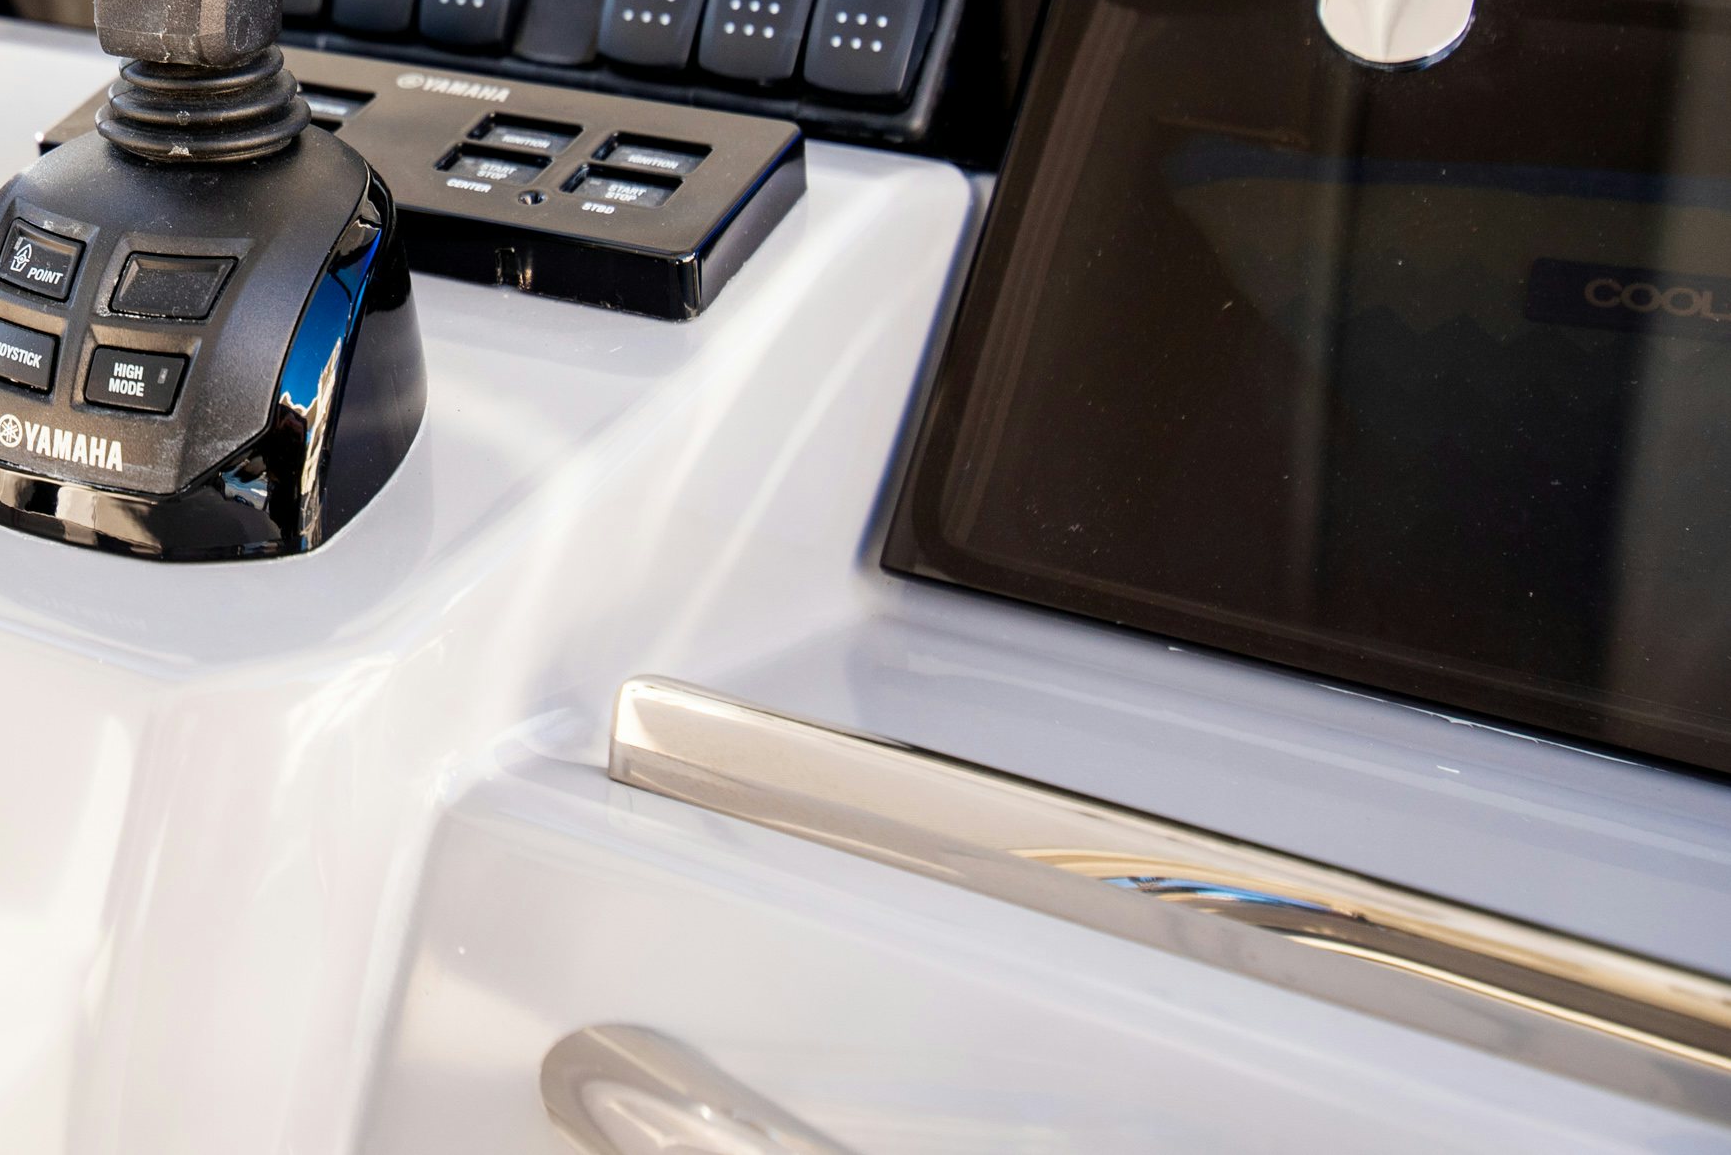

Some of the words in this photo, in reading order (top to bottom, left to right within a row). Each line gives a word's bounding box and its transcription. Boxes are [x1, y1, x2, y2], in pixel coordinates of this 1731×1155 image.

[422, 77, 510, 103] YAMAHA
[501, 134, 550, 149] IGNITION
[480, 163, 518, 175] START
[628, 154, 679, 170] IGNITION
[477, 170, 508, 180] STOP
[446, 178, 492, 193] CENTER
[608, 184, 647, 196] START
[605, 191, 637, 202] STOP
[582, 202, 615, 214] STBD
[27, 267, 63, 284] POINT
[114, 362, 144, 380] HIGH
[109, 379, 145, 397] MODE
[24, 421, 123, 471] YAMAHA
